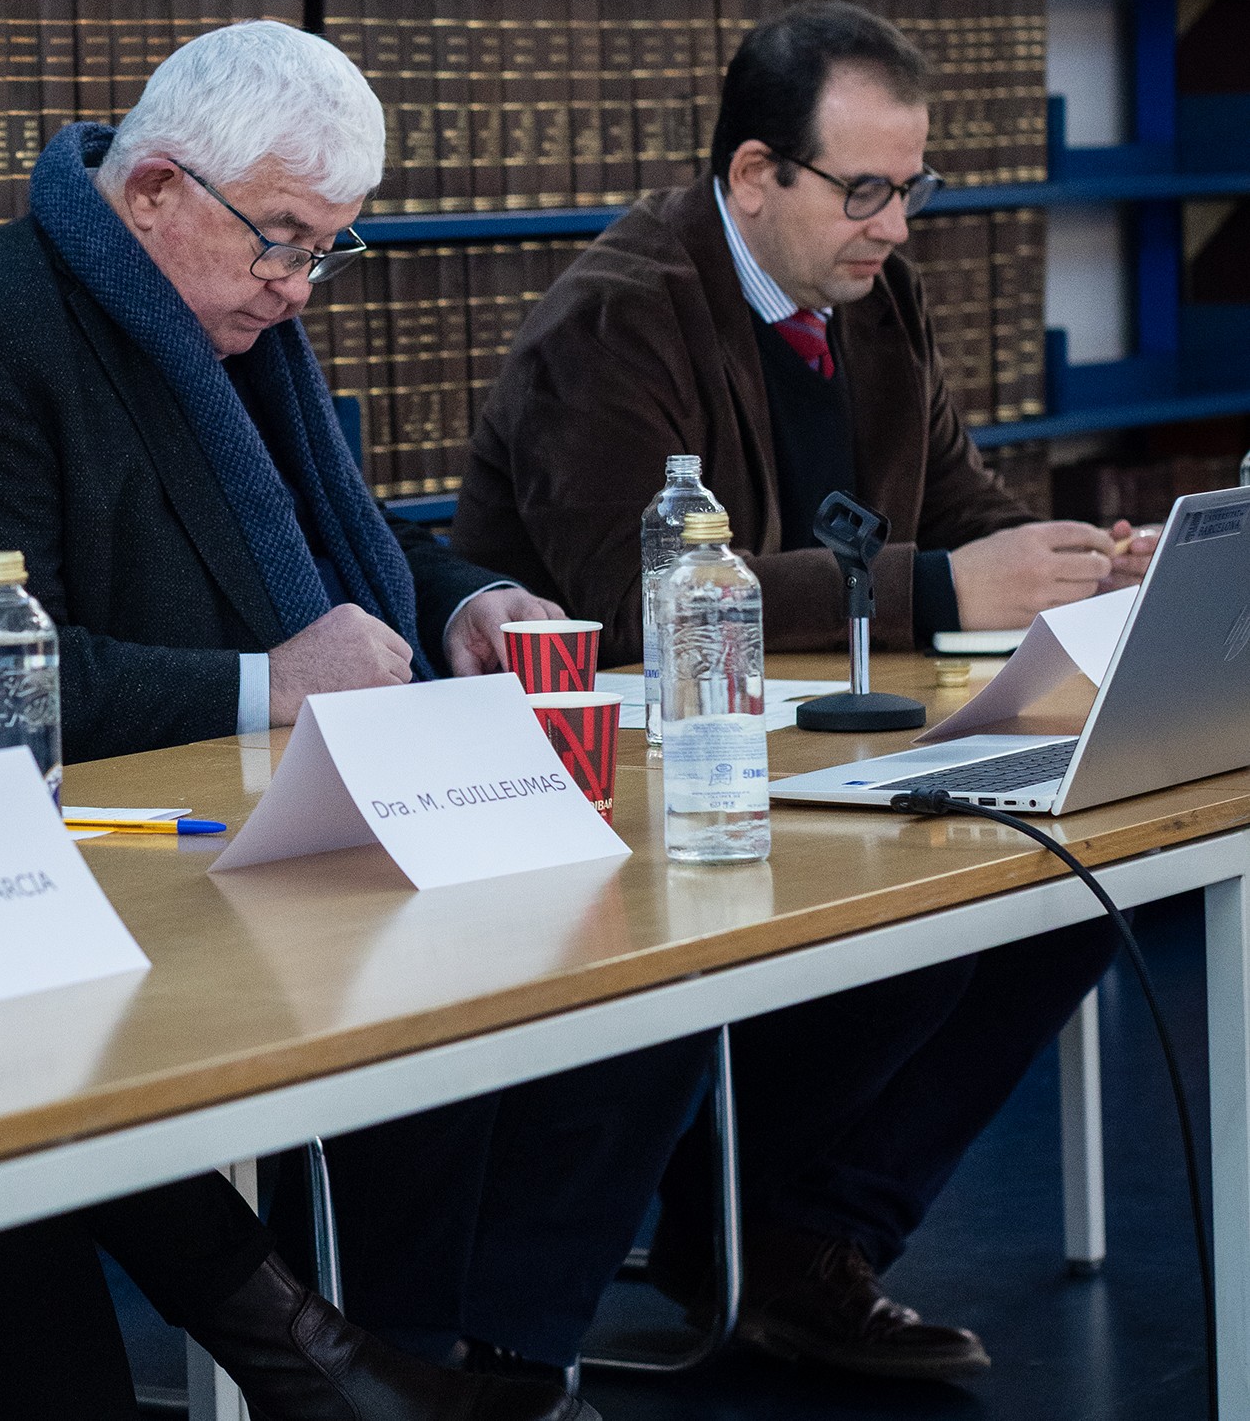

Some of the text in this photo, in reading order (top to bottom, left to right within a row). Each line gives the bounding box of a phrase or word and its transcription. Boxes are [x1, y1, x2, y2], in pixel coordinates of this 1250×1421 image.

[371, 773, 568, 819] Dra. M. GUILLEUMAS
